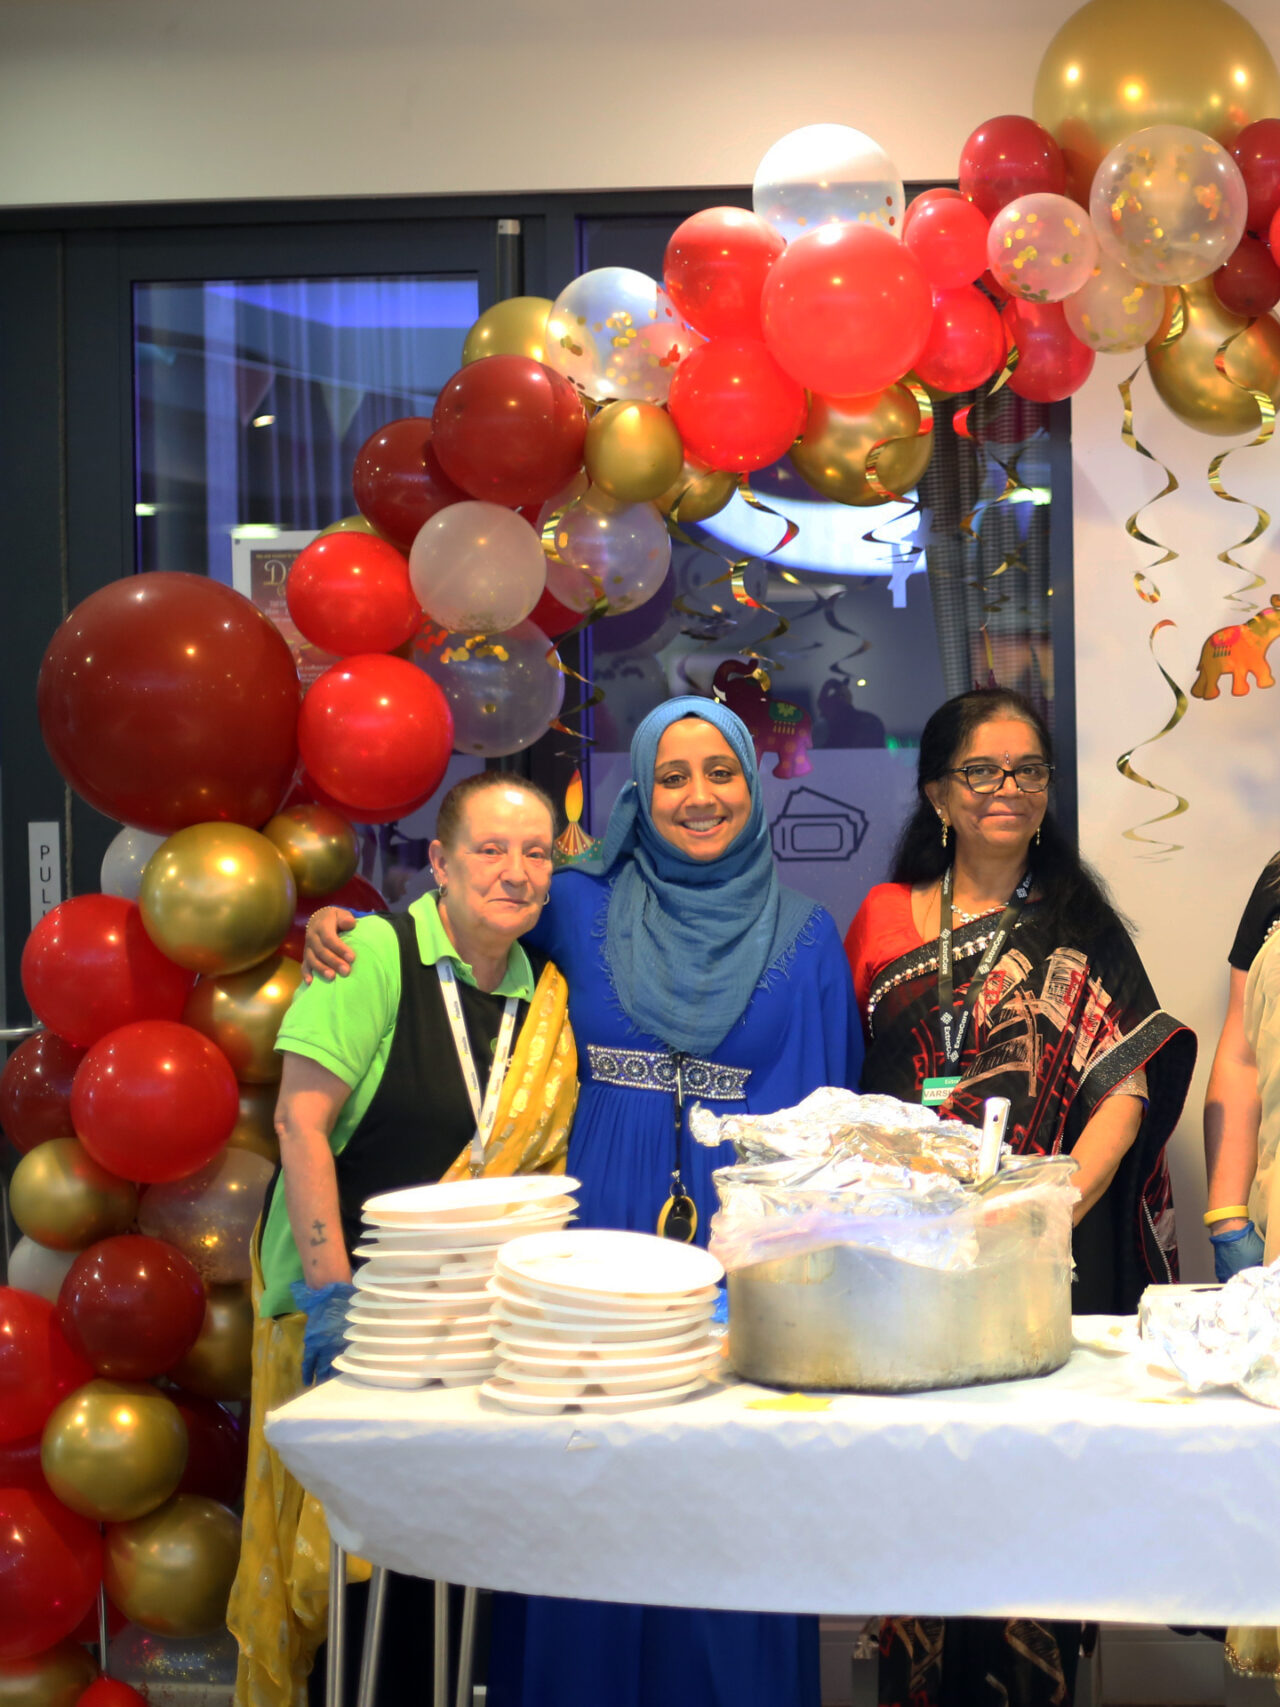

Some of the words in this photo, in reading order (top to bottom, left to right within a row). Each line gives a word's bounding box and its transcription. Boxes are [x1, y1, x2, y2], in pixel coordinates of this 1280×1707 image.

[40, 845, 51, 917] PUL
[985, 930, 1006, 963] ExtraCare
[954, 1011, 969, 1049] ExtraCare
